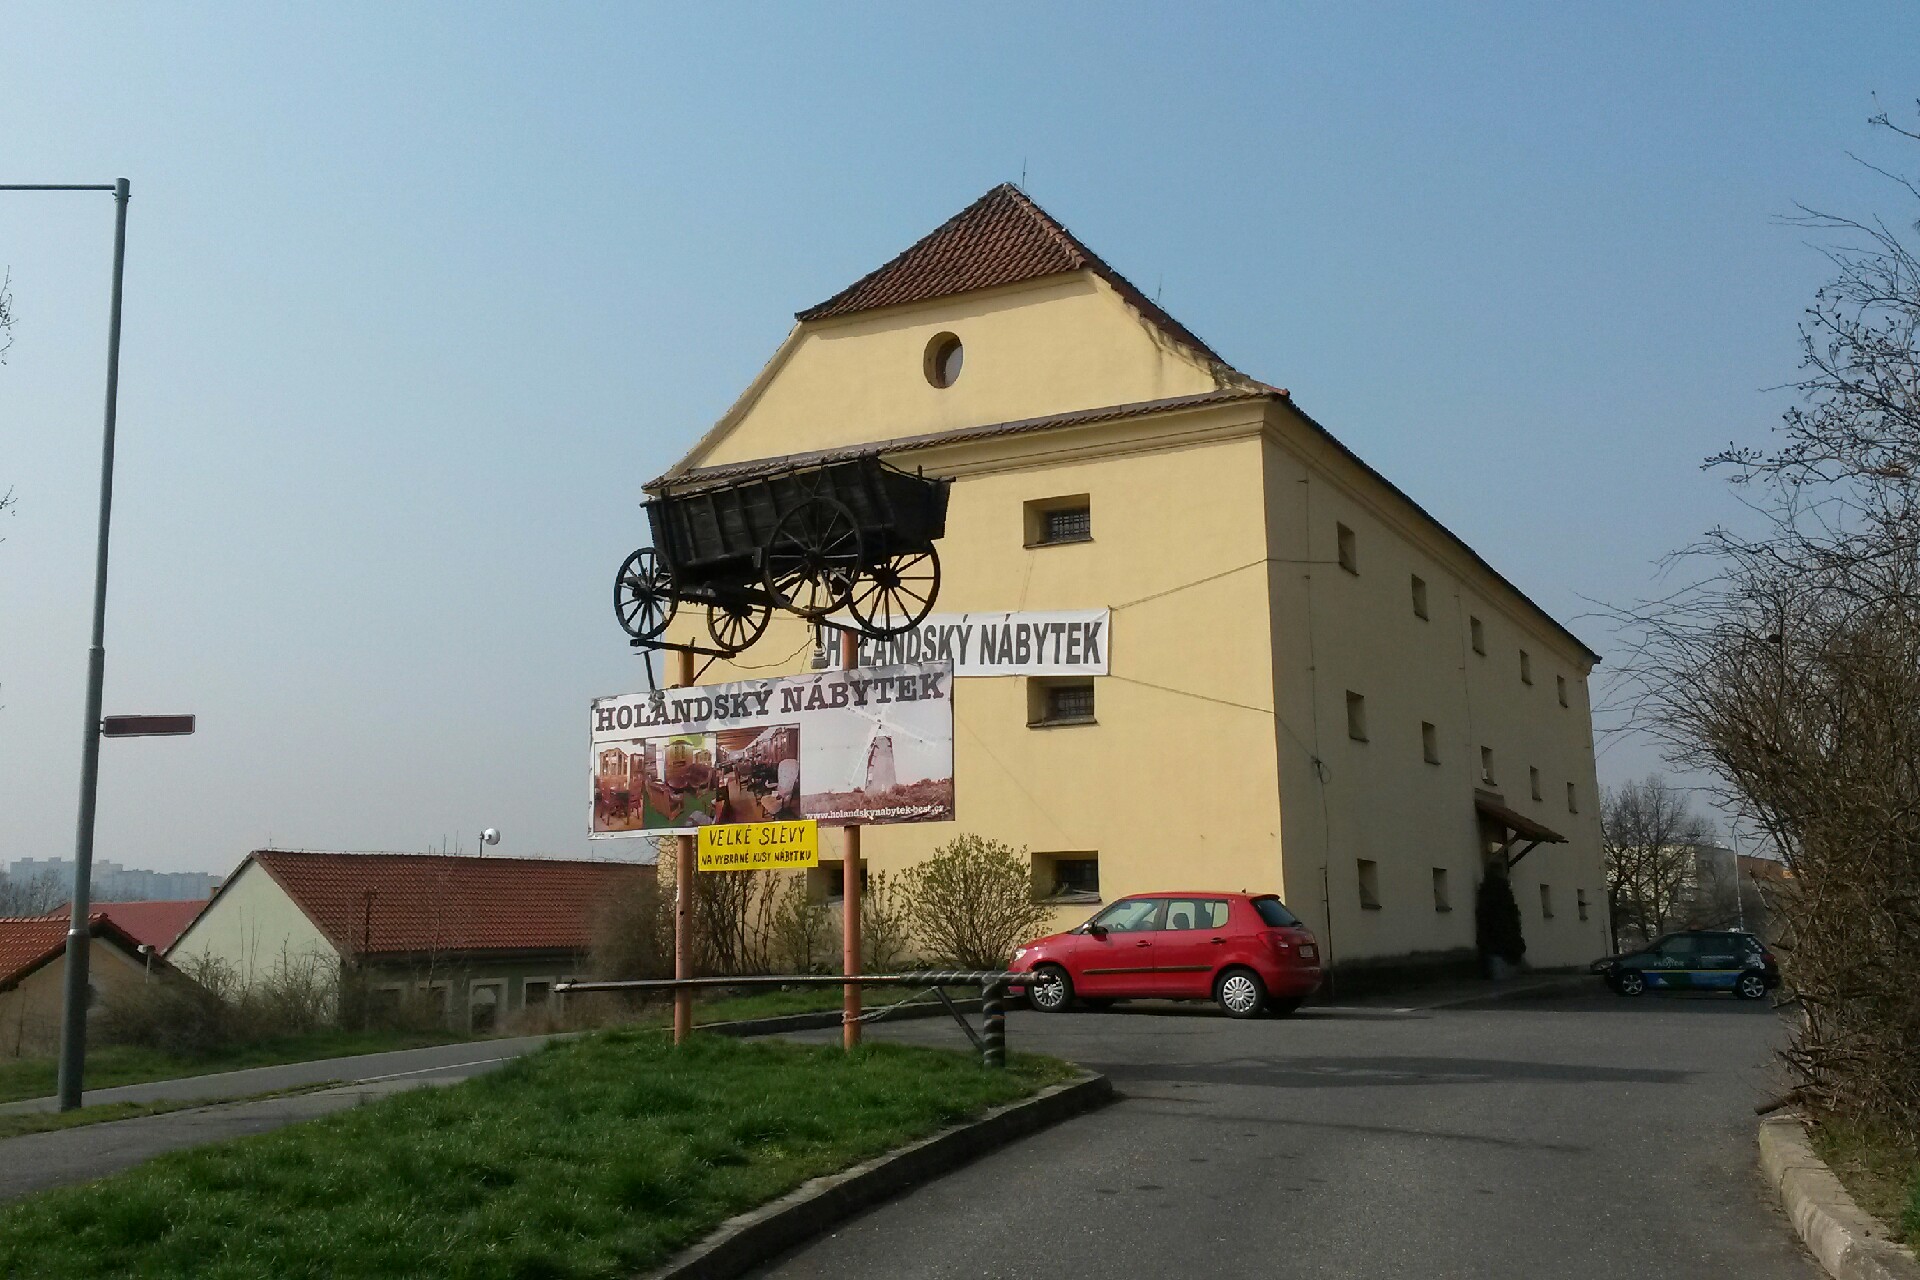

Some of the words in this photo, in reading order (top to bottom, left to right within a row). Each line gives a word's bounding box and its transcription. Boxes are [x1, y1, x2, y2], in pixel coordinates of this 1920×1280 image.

[827, 614, 973, 667] HLANDSKÝ
[980, 614, 1102, 665] NÁBYTEK
[595, 682, 773, 732] HOLANDSKÝ
[780, 672, 945, 714] NÁBYTEK
[805, 804, 944, 820] www.holandskynabytek-best.cz
[709, 825, 752, 846] VELKÉ
[701, 854, 712, 865] NA
[715, 850, 749, 864] VYBRANÉ
[753, 851, 771, 863] KUSY
[774, 848, 812, 862] NÁBYTKU
